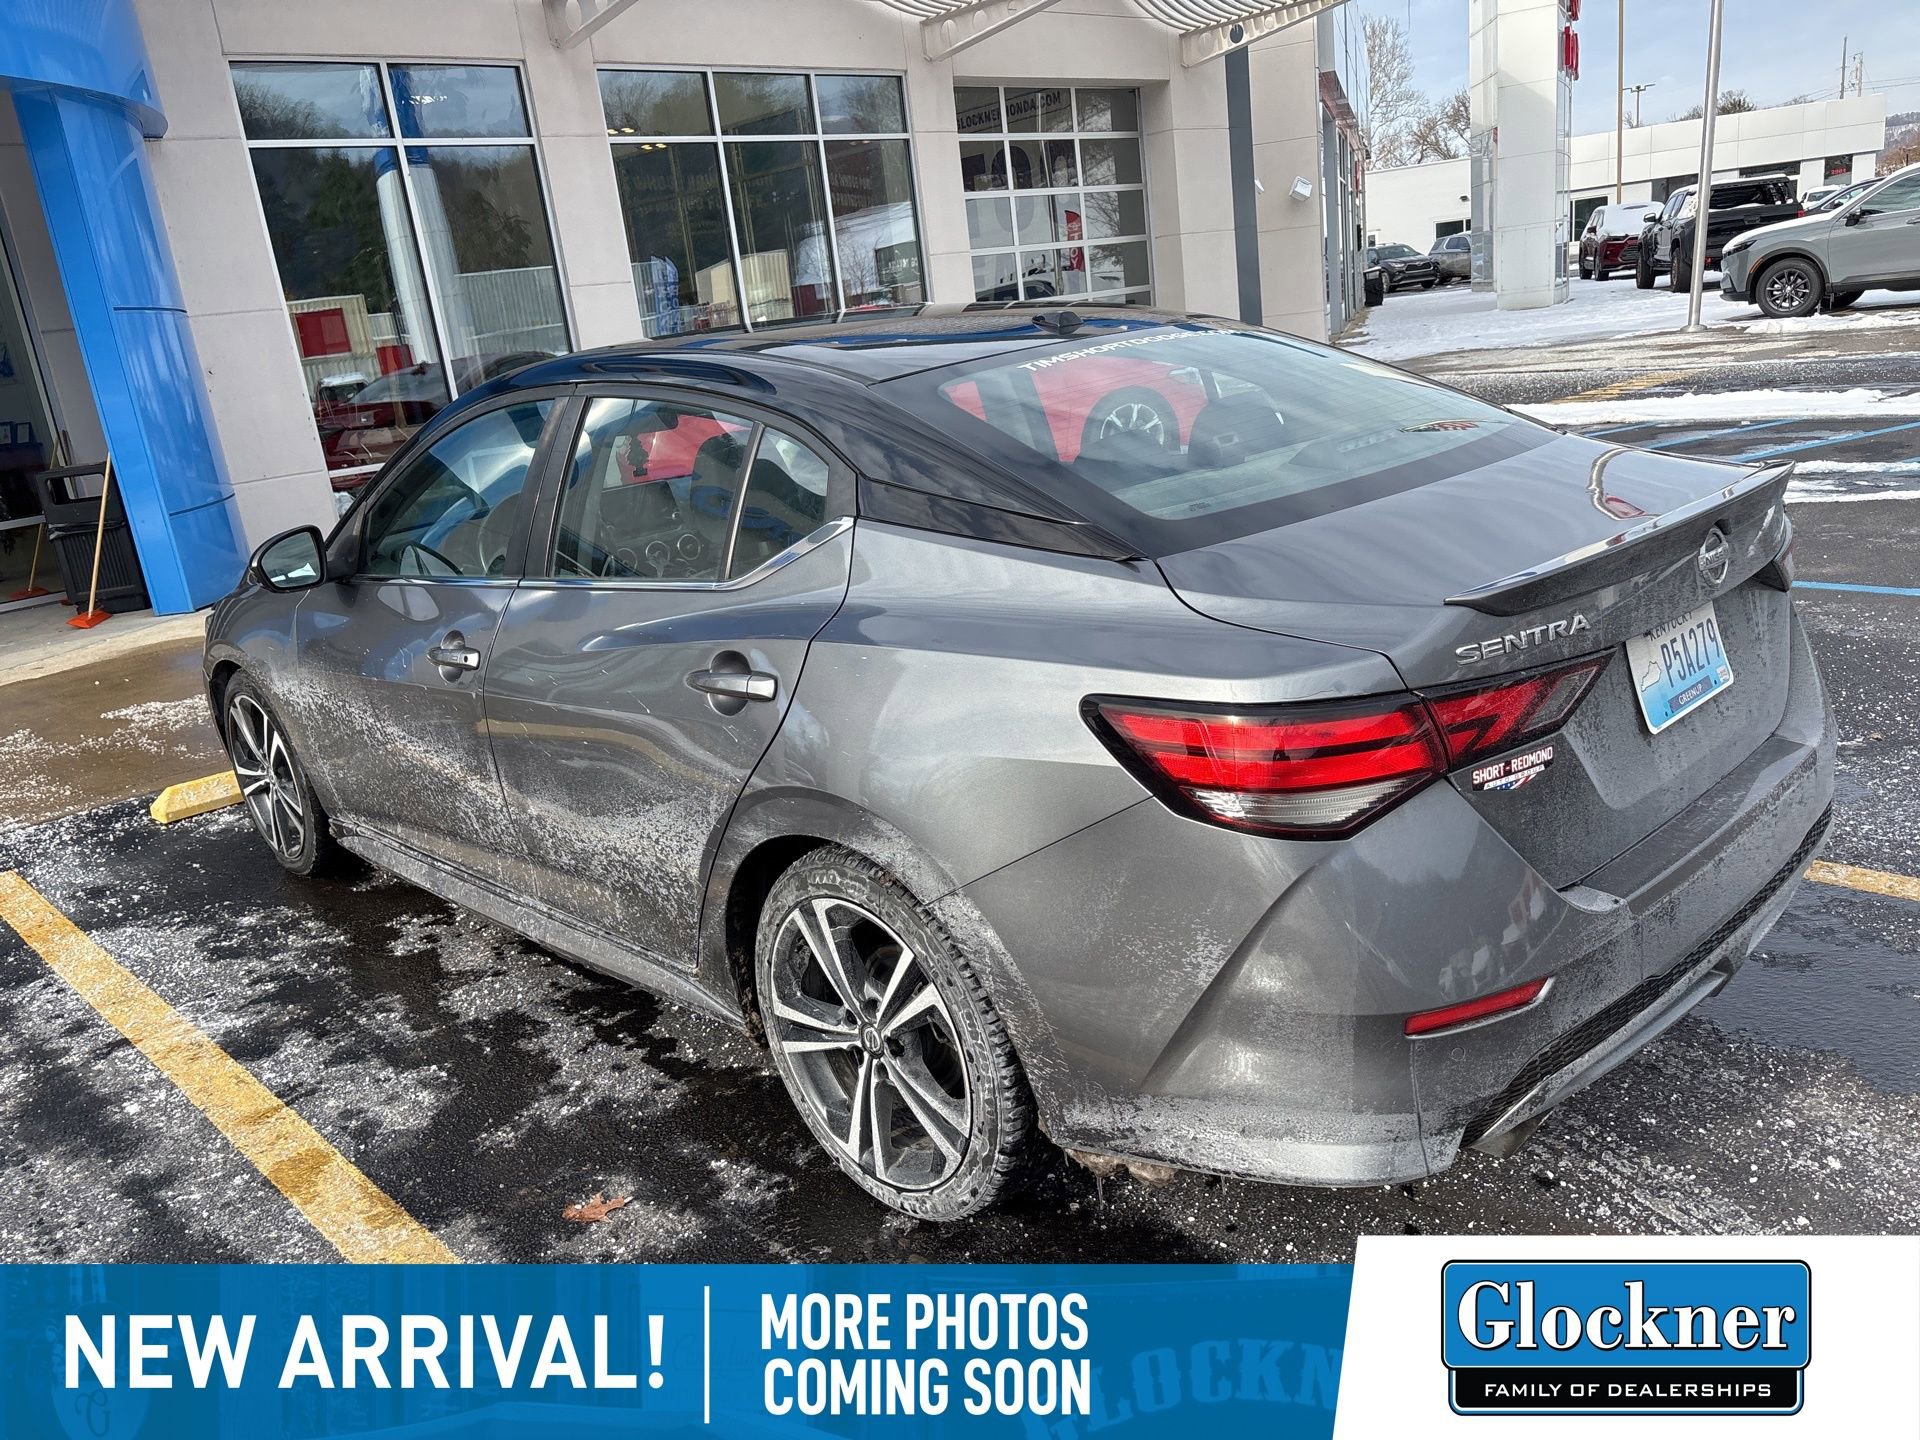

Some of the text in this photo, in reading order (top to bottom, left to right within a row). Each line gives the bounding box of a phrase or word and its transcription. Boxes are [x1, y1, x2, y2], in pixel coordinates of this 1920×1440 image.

[1455, 613, 1592, 666] SENTRA
[1660, 617, 1721, 689] P5A279
[1678, 684, 1703, 706] GREENUP
